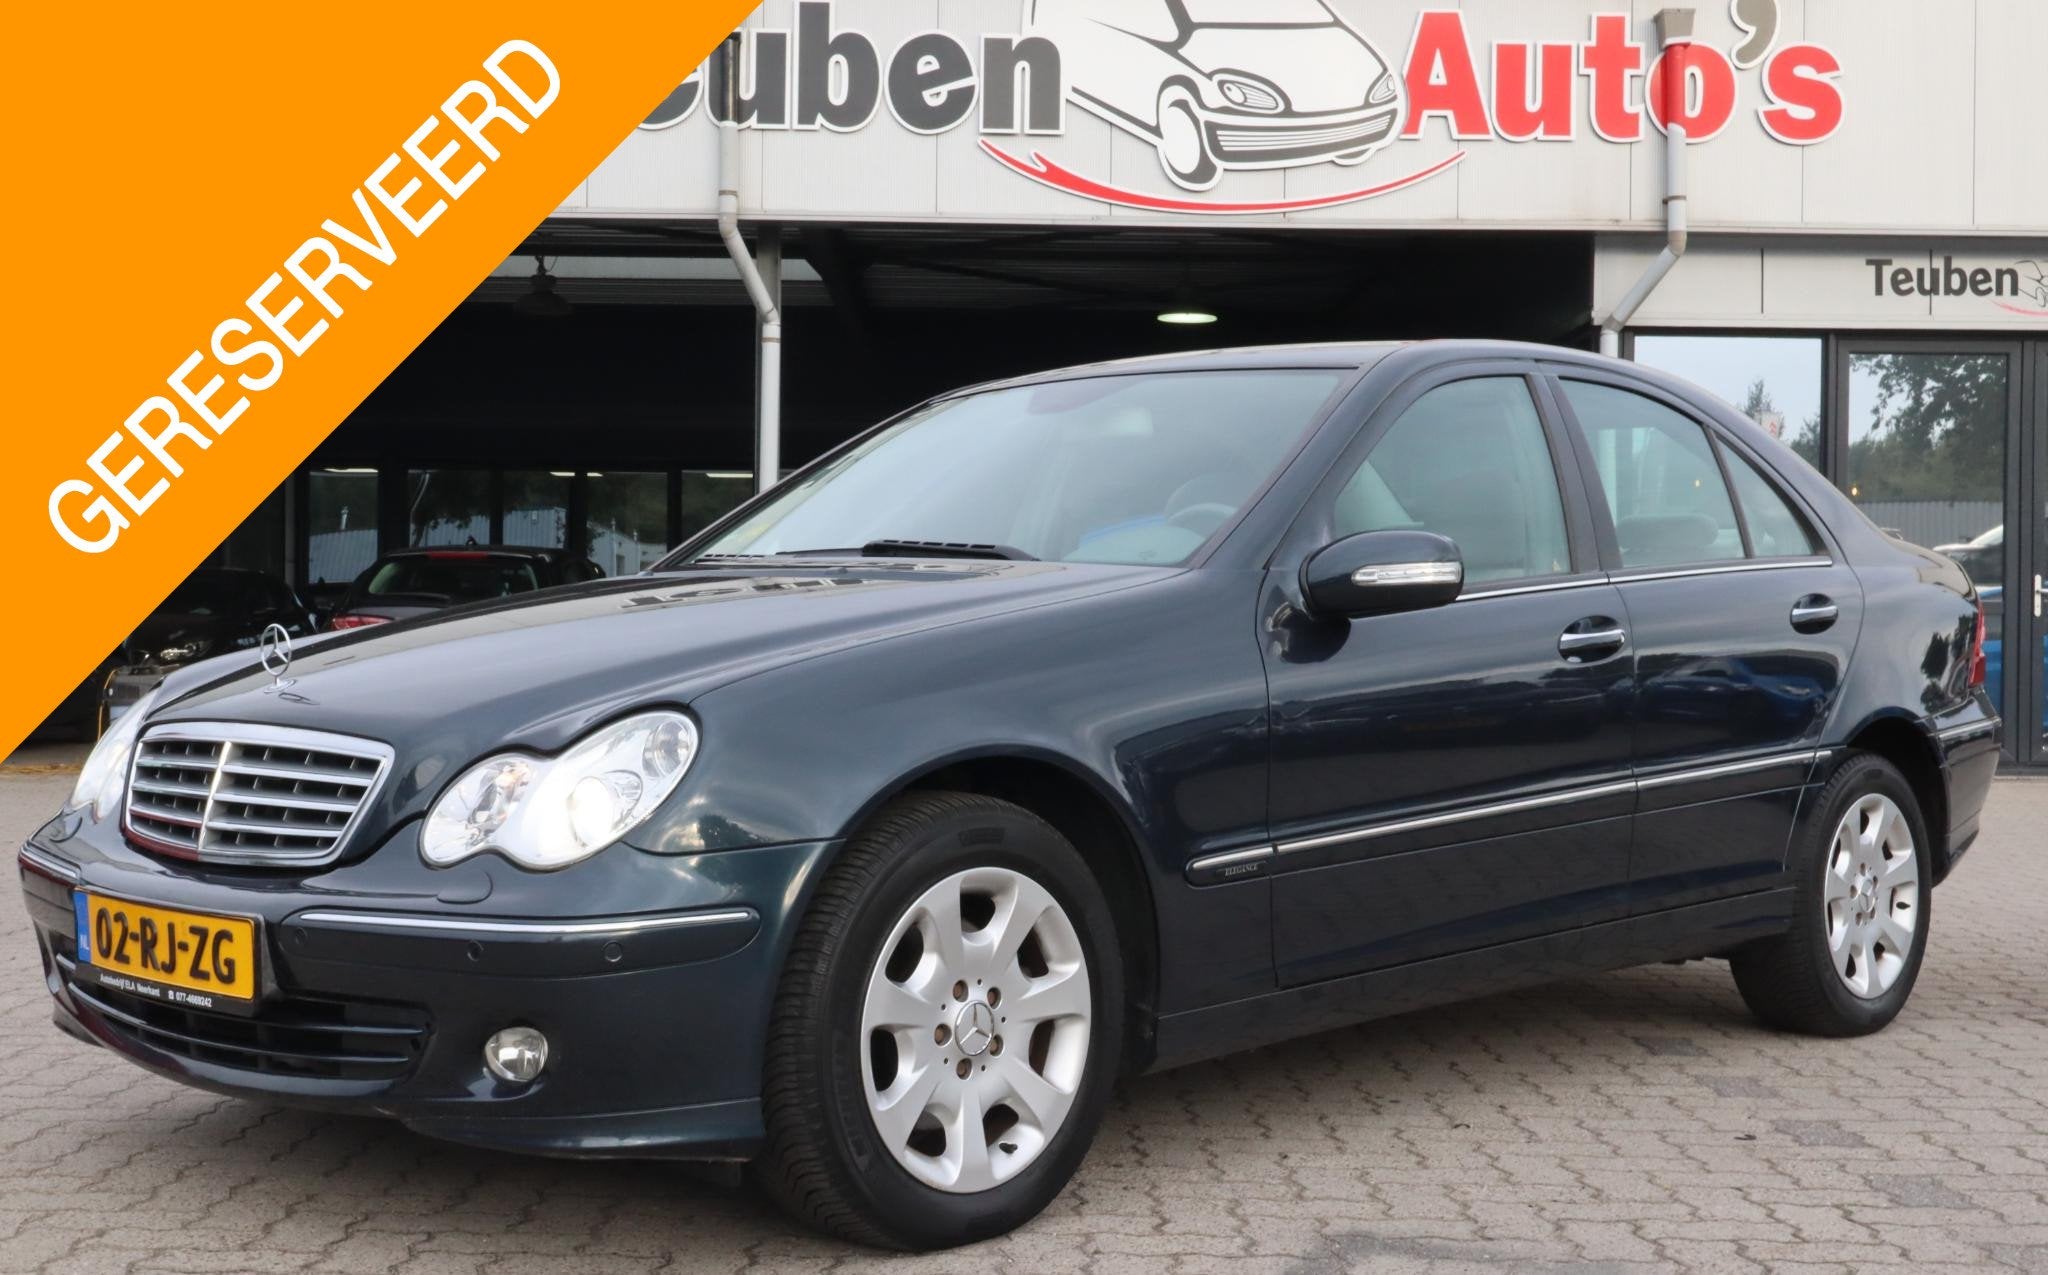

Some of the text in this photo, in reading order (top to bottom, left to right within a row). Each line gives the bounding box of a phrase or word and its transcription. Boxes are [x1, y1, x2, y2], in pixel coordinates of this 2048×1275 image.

[1401, 0, 1844, 143] Auto's
[1865, 255, 2019, 297] Teuben
[96, 907, 236, 984] 02-RJ-ZG
